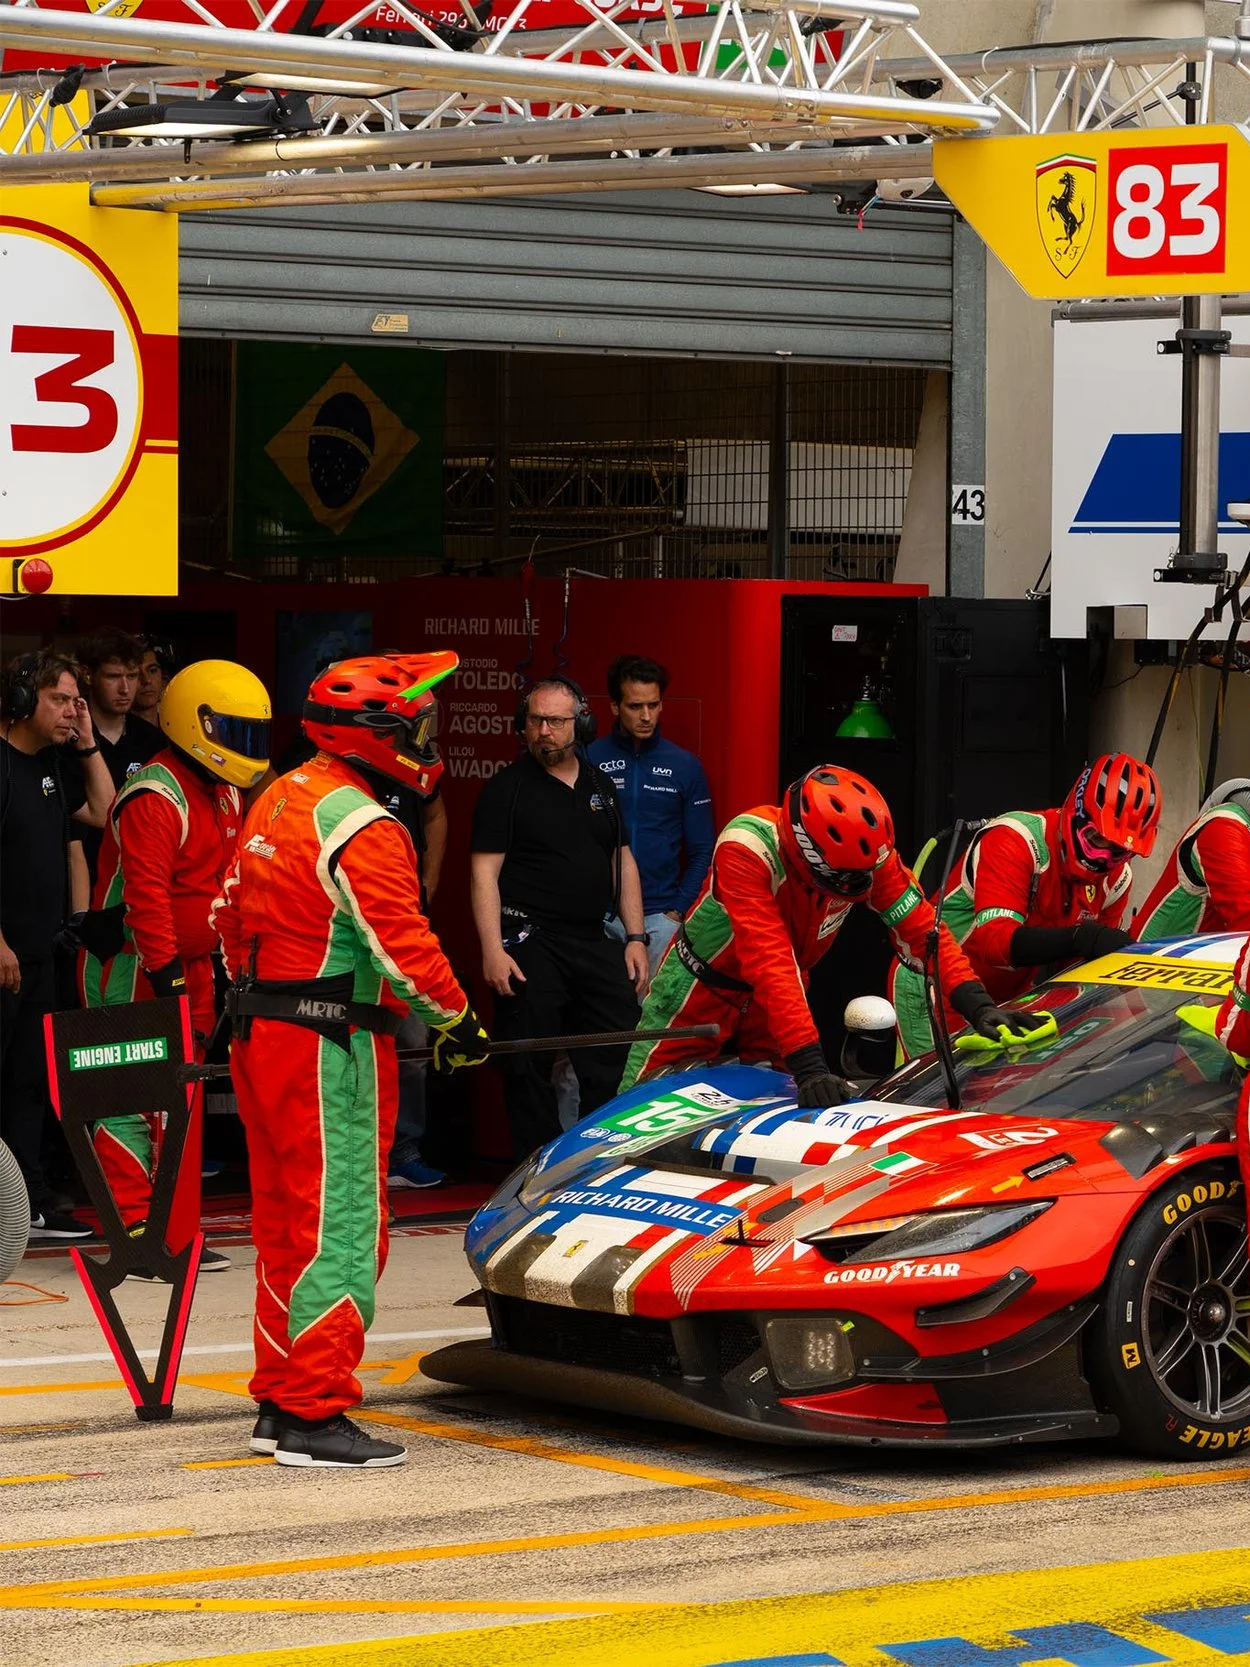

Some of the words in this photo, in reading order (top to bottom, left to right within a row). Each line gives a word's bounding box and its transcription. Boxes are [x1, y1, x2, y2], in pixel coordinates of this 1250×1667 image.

[1112, 162, 1221, 259] 83
[11, 324, 118, 453] 3
[952, 489, 985, 521] 43
[425, 618, 489, 636] RICHARD
[495, 619, 540, 636] MILLE
[457, 658, 498, 669] USTODIO
[452, 671, 525, 691] TOLEDO
[450, 702, 497, 712] RICCARDO
[449, 715, 516, 735] AGOST
[449, 747, 474, 757] LILOU
[600, 760, 625, 770] octa
[1075, 768, 1091, 819] OAKLEY
[890, 891, 919, 922] PITLANE
[982, 909, 1015, 921] PITLANE
[1098, 961, 1235, 990] Ferrar
[296, 1000, 347, 1021] MRTC
[73, 1047, 122, 1068] ENGINE
[124, 1041, 164, 1063] START
[616, 1100, 715, 1132] 15
[551, 1190, 661, 1217] RICHARD
[654, 1202, 734, 1229] MILLE
[1162, 1181, 1225, 1225] GOOD
[824, 1260, 961, 1284] GOODYEAR
